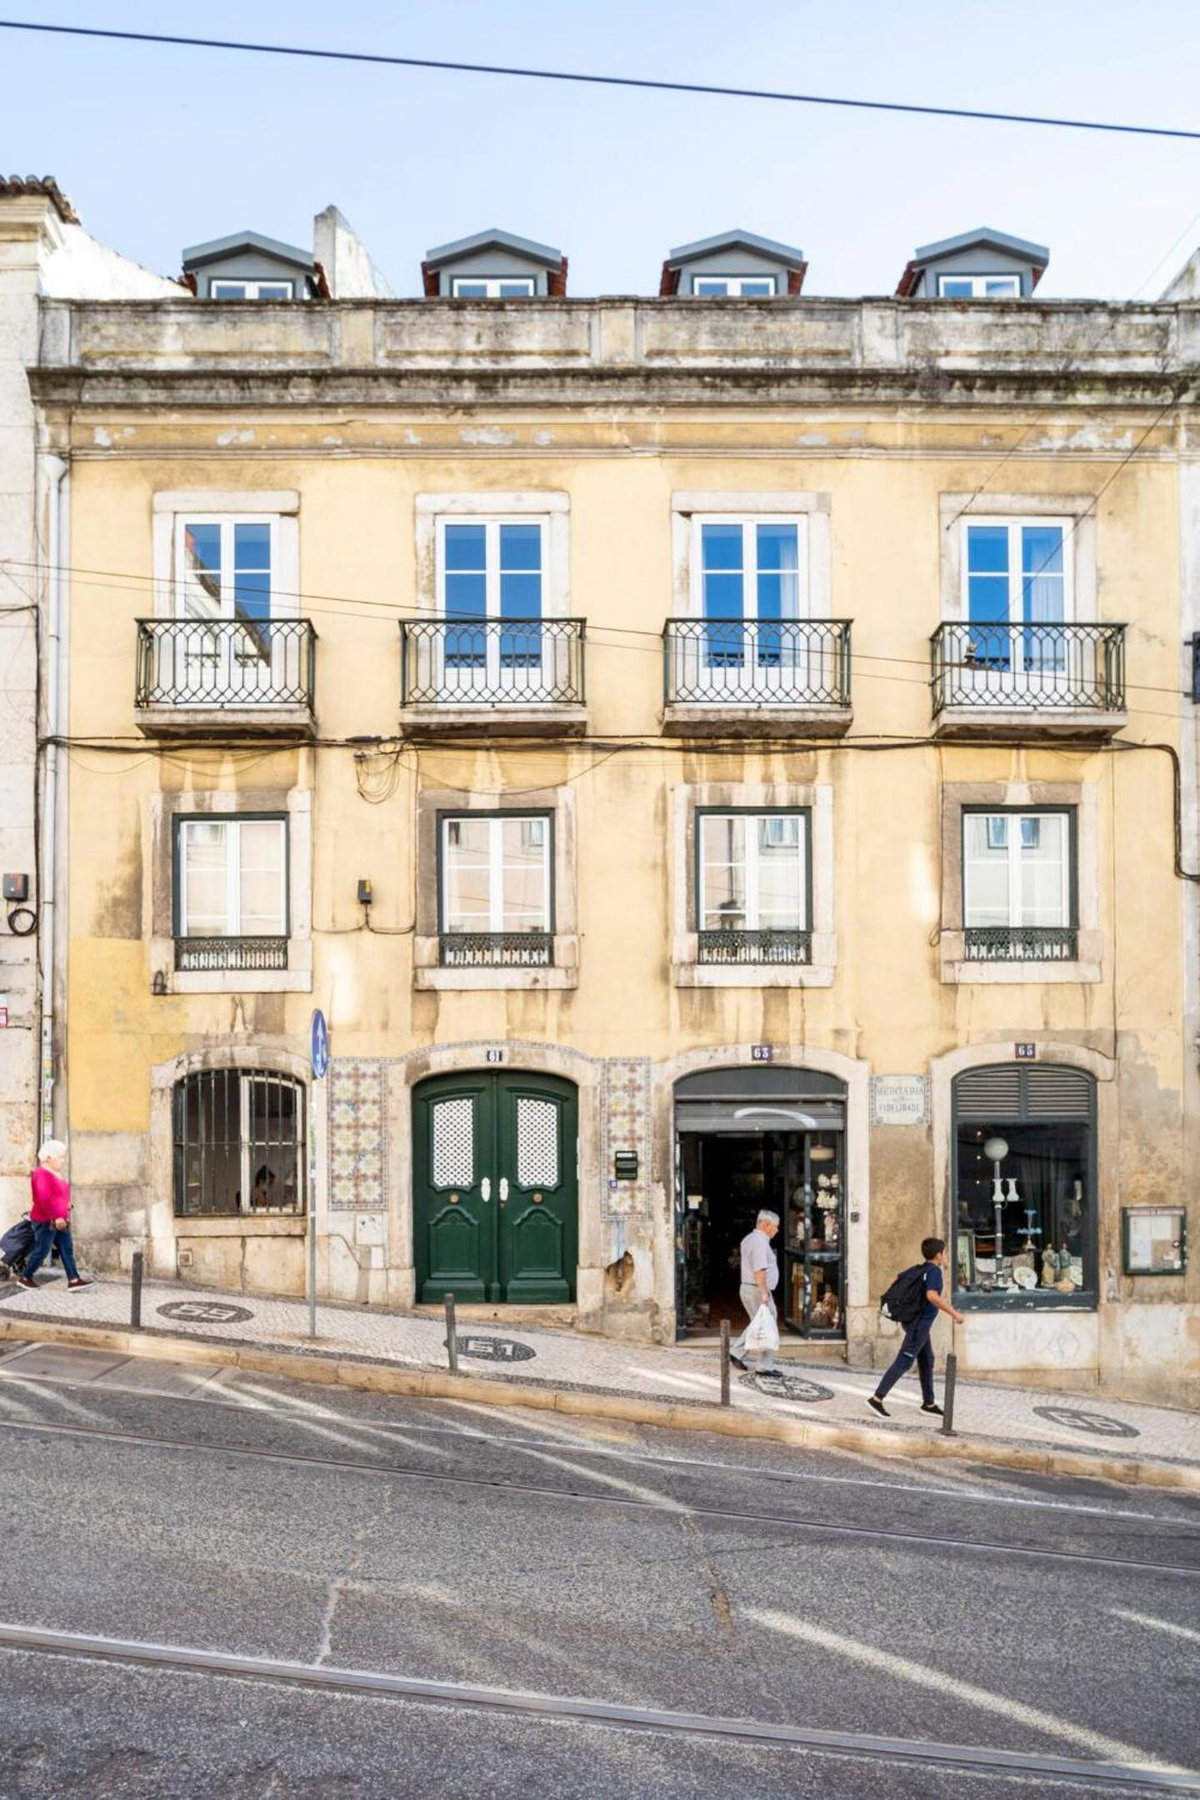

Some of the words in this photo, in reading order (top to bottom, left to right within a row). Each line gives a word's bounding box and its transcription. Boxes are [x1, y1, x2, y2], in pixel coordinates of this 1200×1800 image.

[754, 1047, 769, 1058] 63
[1018, 1044, 1033, 1056] 65
[488, 1051, 499, 1061] 61
